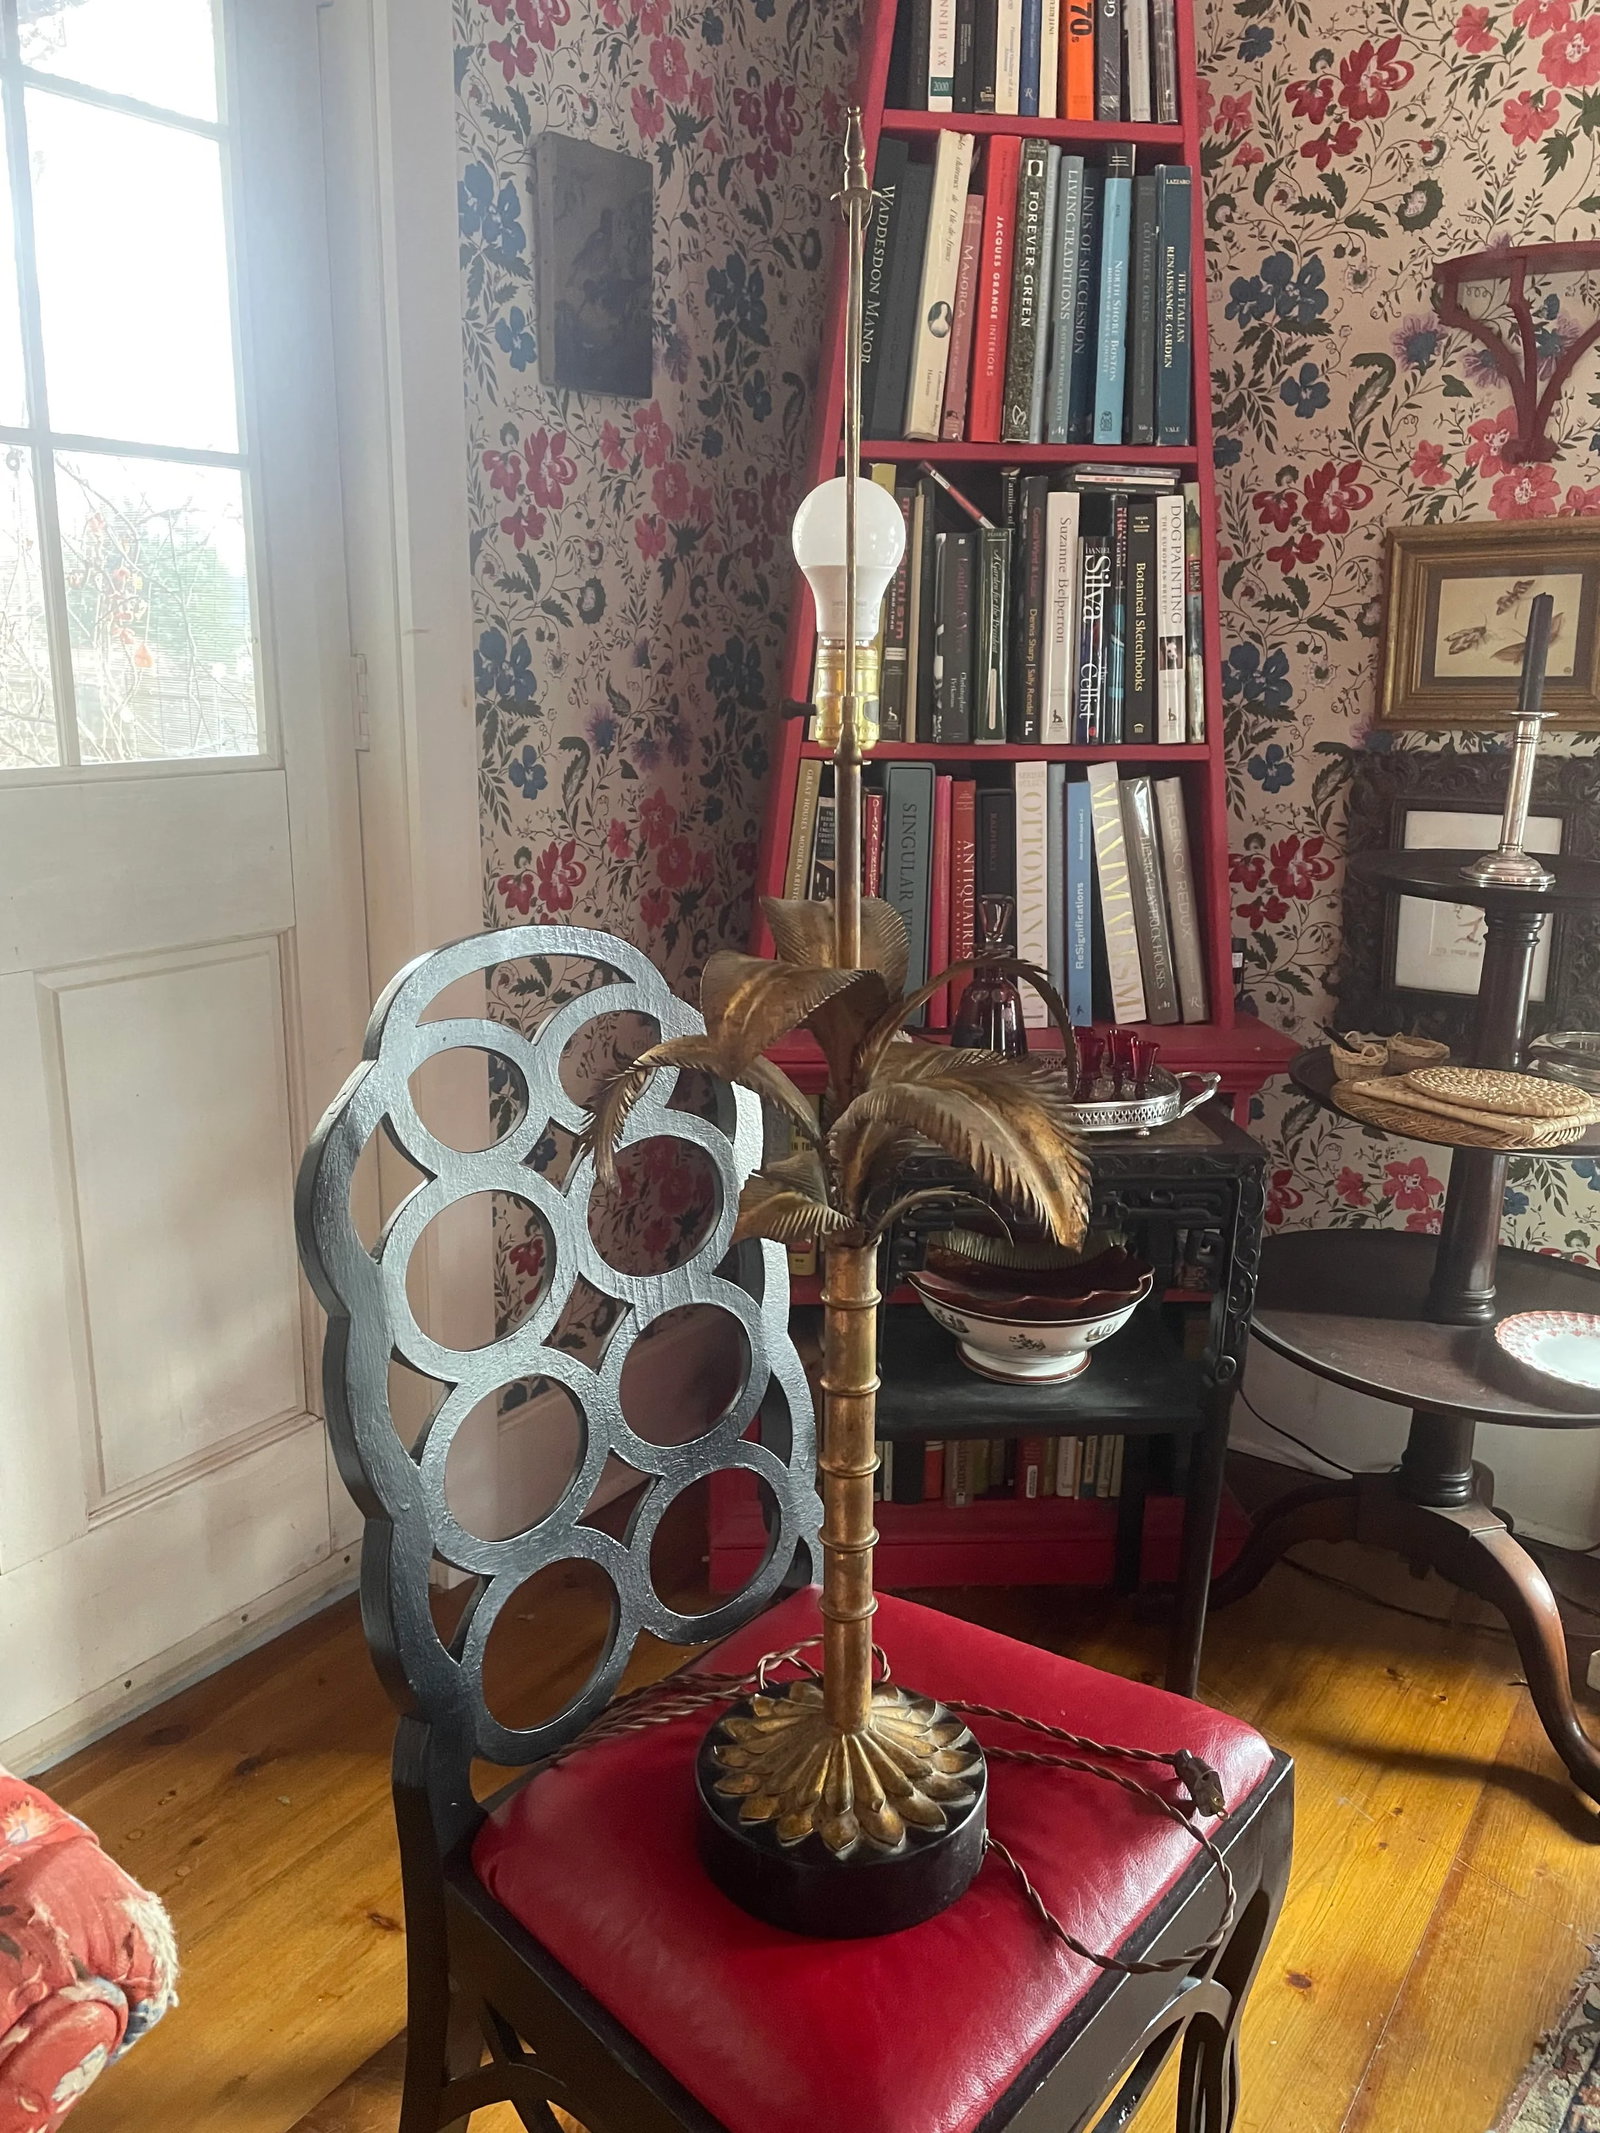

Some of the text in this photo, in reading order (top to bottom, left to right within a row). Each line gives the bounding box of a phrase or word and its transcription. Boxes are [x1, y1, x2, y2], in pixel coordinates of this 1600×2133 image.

[1070, 1, 1093, 43] 70s
[933, 82, 949, 92] 2000
[991, 215, 1004, 267] JACQUES
[1021, 191, 1040, 328] FOREVER GREEN
[1060, 169, 1078, 321] LIVING TRADITIONS
[1142, 221, 1152, 280] COTTAGES
[859, 183, 897, 364] WADDESDON MANOR
[957, 245, 975, 319] MAJORCA
[989, 272, 1001, 320] GRANGE
[1073, 186, 1094, 354] LINES OF SUCCESSION
[1109, 260, 1123, 382] NORTH SHORE BOSTON
[1164, 246, 1175, 368] RENAISSANCE GARDEN
[1176, 271, 1187, 343] THE ITALIAN
[986, 323, 997, 377] INTERIORS
[1006, 476, 1017, 514] Families
[991, 562, 1001, 590] Garden
[1053, 516, 1072, 644] Suzanne Belperron
[1082, 554, 1112, 624] Silva
[1170, 505, 1183, 624] DOG PAINTING
[991, 590, 1001, 603] for
[992, 604, 1001, 617] the
[1028, 608, 1038, 637] Dennis
[992, 618, 1000, 654] President
[1026, 638, 1036, 662] Sharp
[1134, 562, 1146, 692] Botanical Sketchbooks
[1026, 668, 1036, 687] Sally
[1026, 688, 1035, 716] Rendel
[1078, 663, 1100, 719] Cellist
[803, 769, 814, 796] GREAT
[800, 798, 811, 831] HOUSES
[795, 834, 806, 871] MODERN
[899, 803, 917, 901] SINGULAR
[1022, 791, 1044, 935] OTTOMAN
[1139, 835, 1153, 875] HENRY
[1165, 793, 1185, 875] REGENCY
[1175, 879, 1193, 940] REDUX
[959, 840, 975, 959] ANTIQUAIRES
[1092, 782, 1144, 1009] MAXIMALISM
[1074, 882, 1086, 969] ReSignifications
[1148, 906, 1161, 943] FRICK
[1152, 945, 1167, 989] HOUSES
